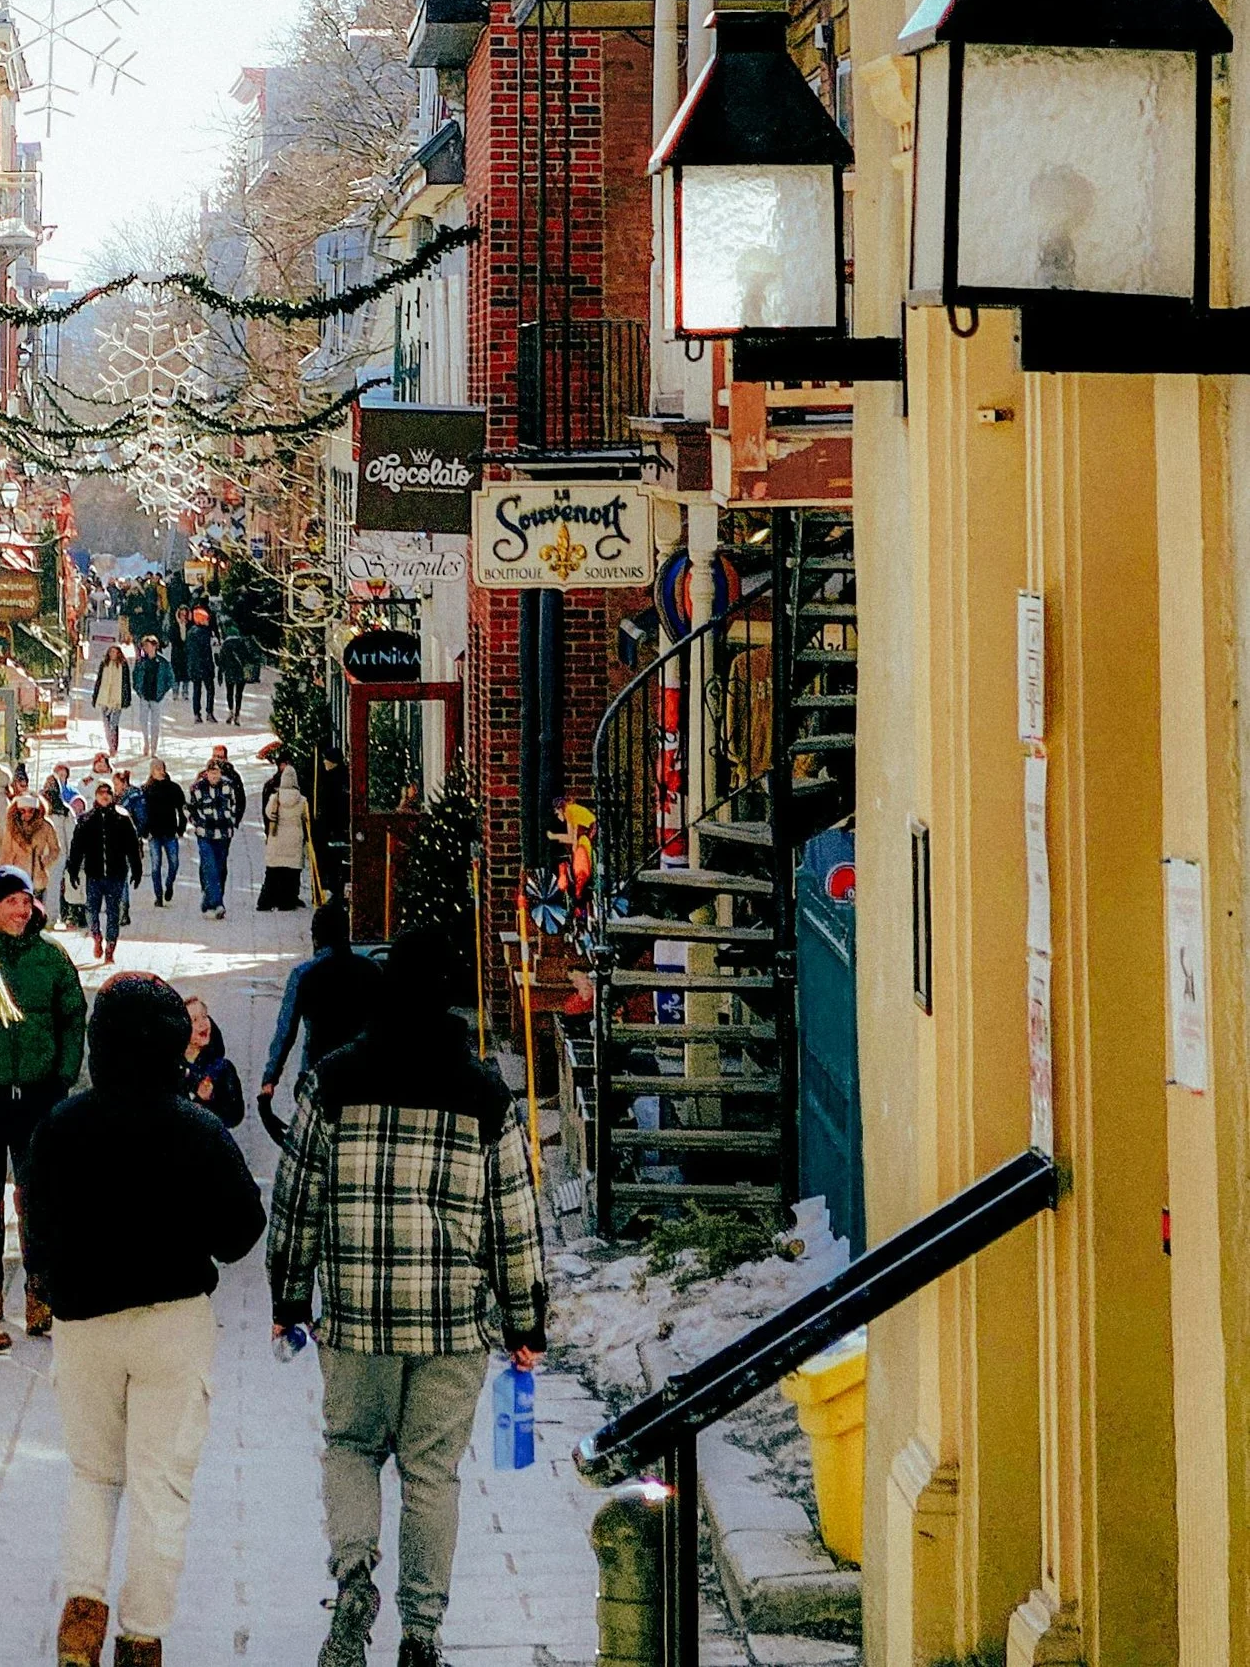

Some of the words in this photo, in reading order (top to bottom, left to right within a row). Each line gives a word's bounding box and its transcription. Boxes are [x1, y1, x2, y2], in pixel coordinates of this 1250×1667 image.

[365, 453, 474, 493] Chocolato
[349, 554, 462, 584] Scrupules
[484, 566, 543, 580] BOUTIQUE
[584, 565, 644, 579] SOUVENIRS
